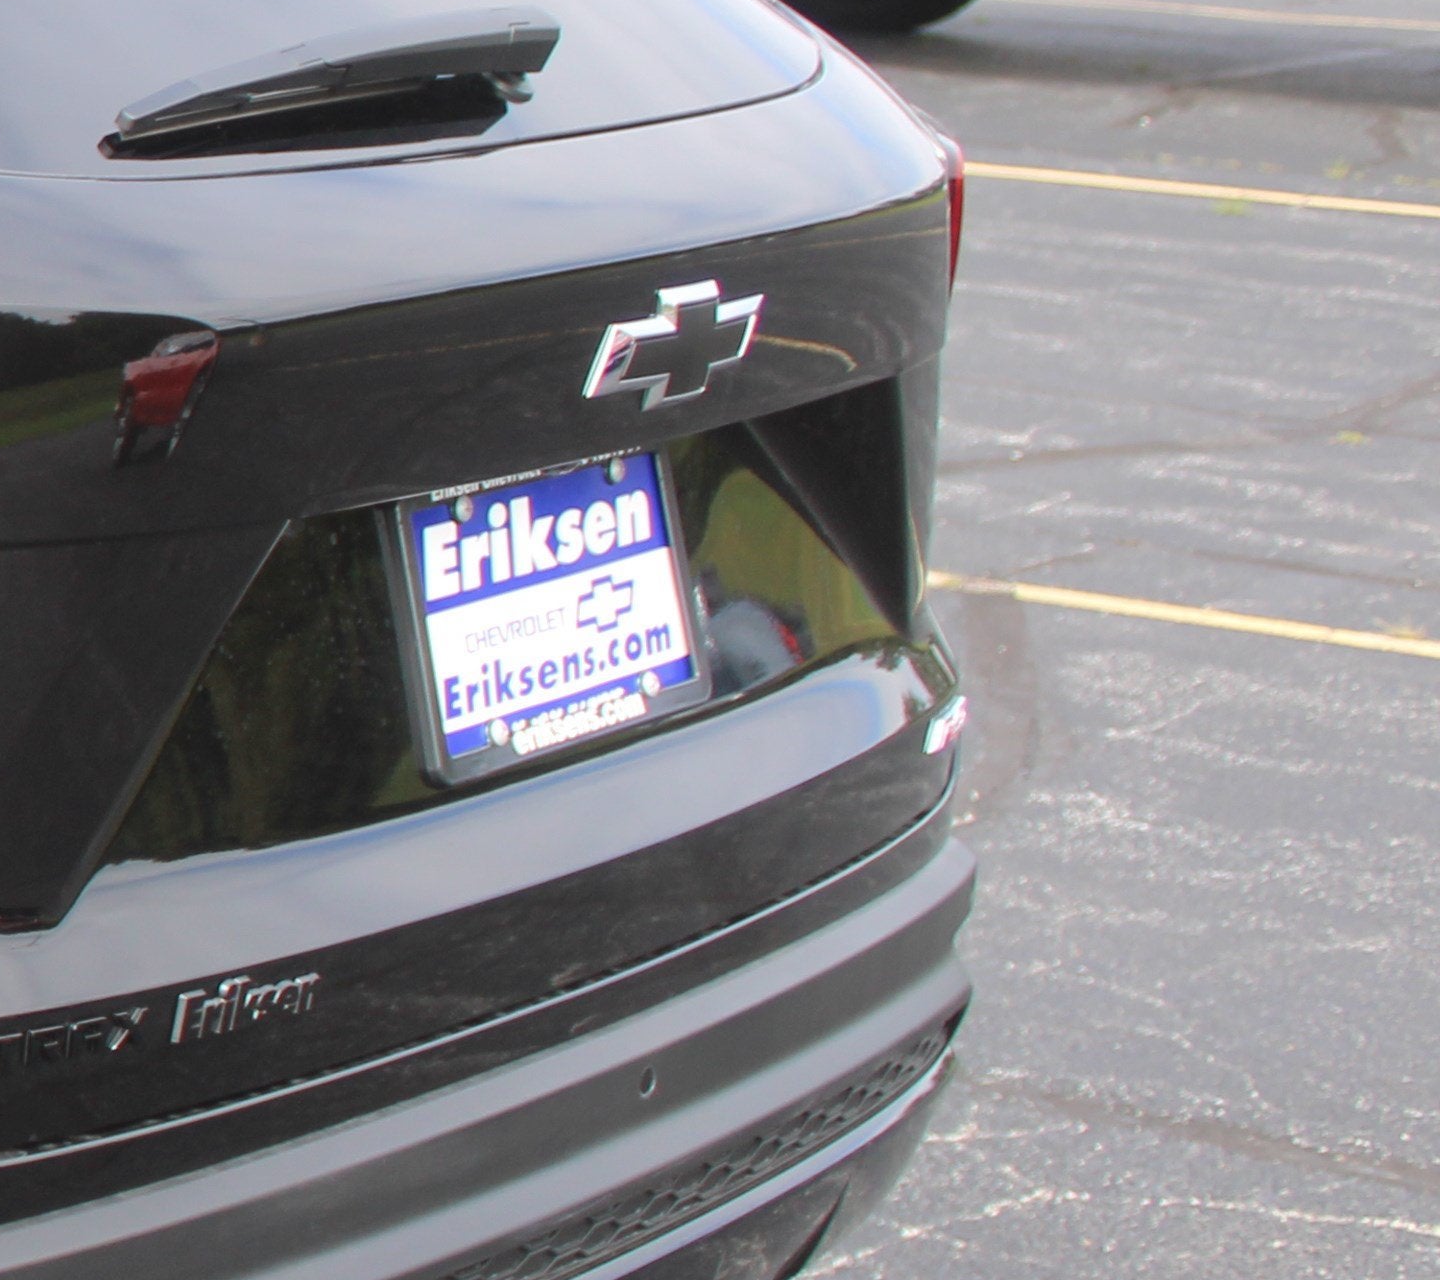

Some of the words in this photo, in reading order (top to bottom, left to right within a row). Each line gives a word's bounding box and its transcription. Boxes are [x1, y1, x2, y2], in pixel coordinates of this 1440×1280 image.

[423, 489, 654, 602] Eriksen
[444, 623, 671, 719] Eriksens.com
[465, 607, 566, 654] CHEVROLET
